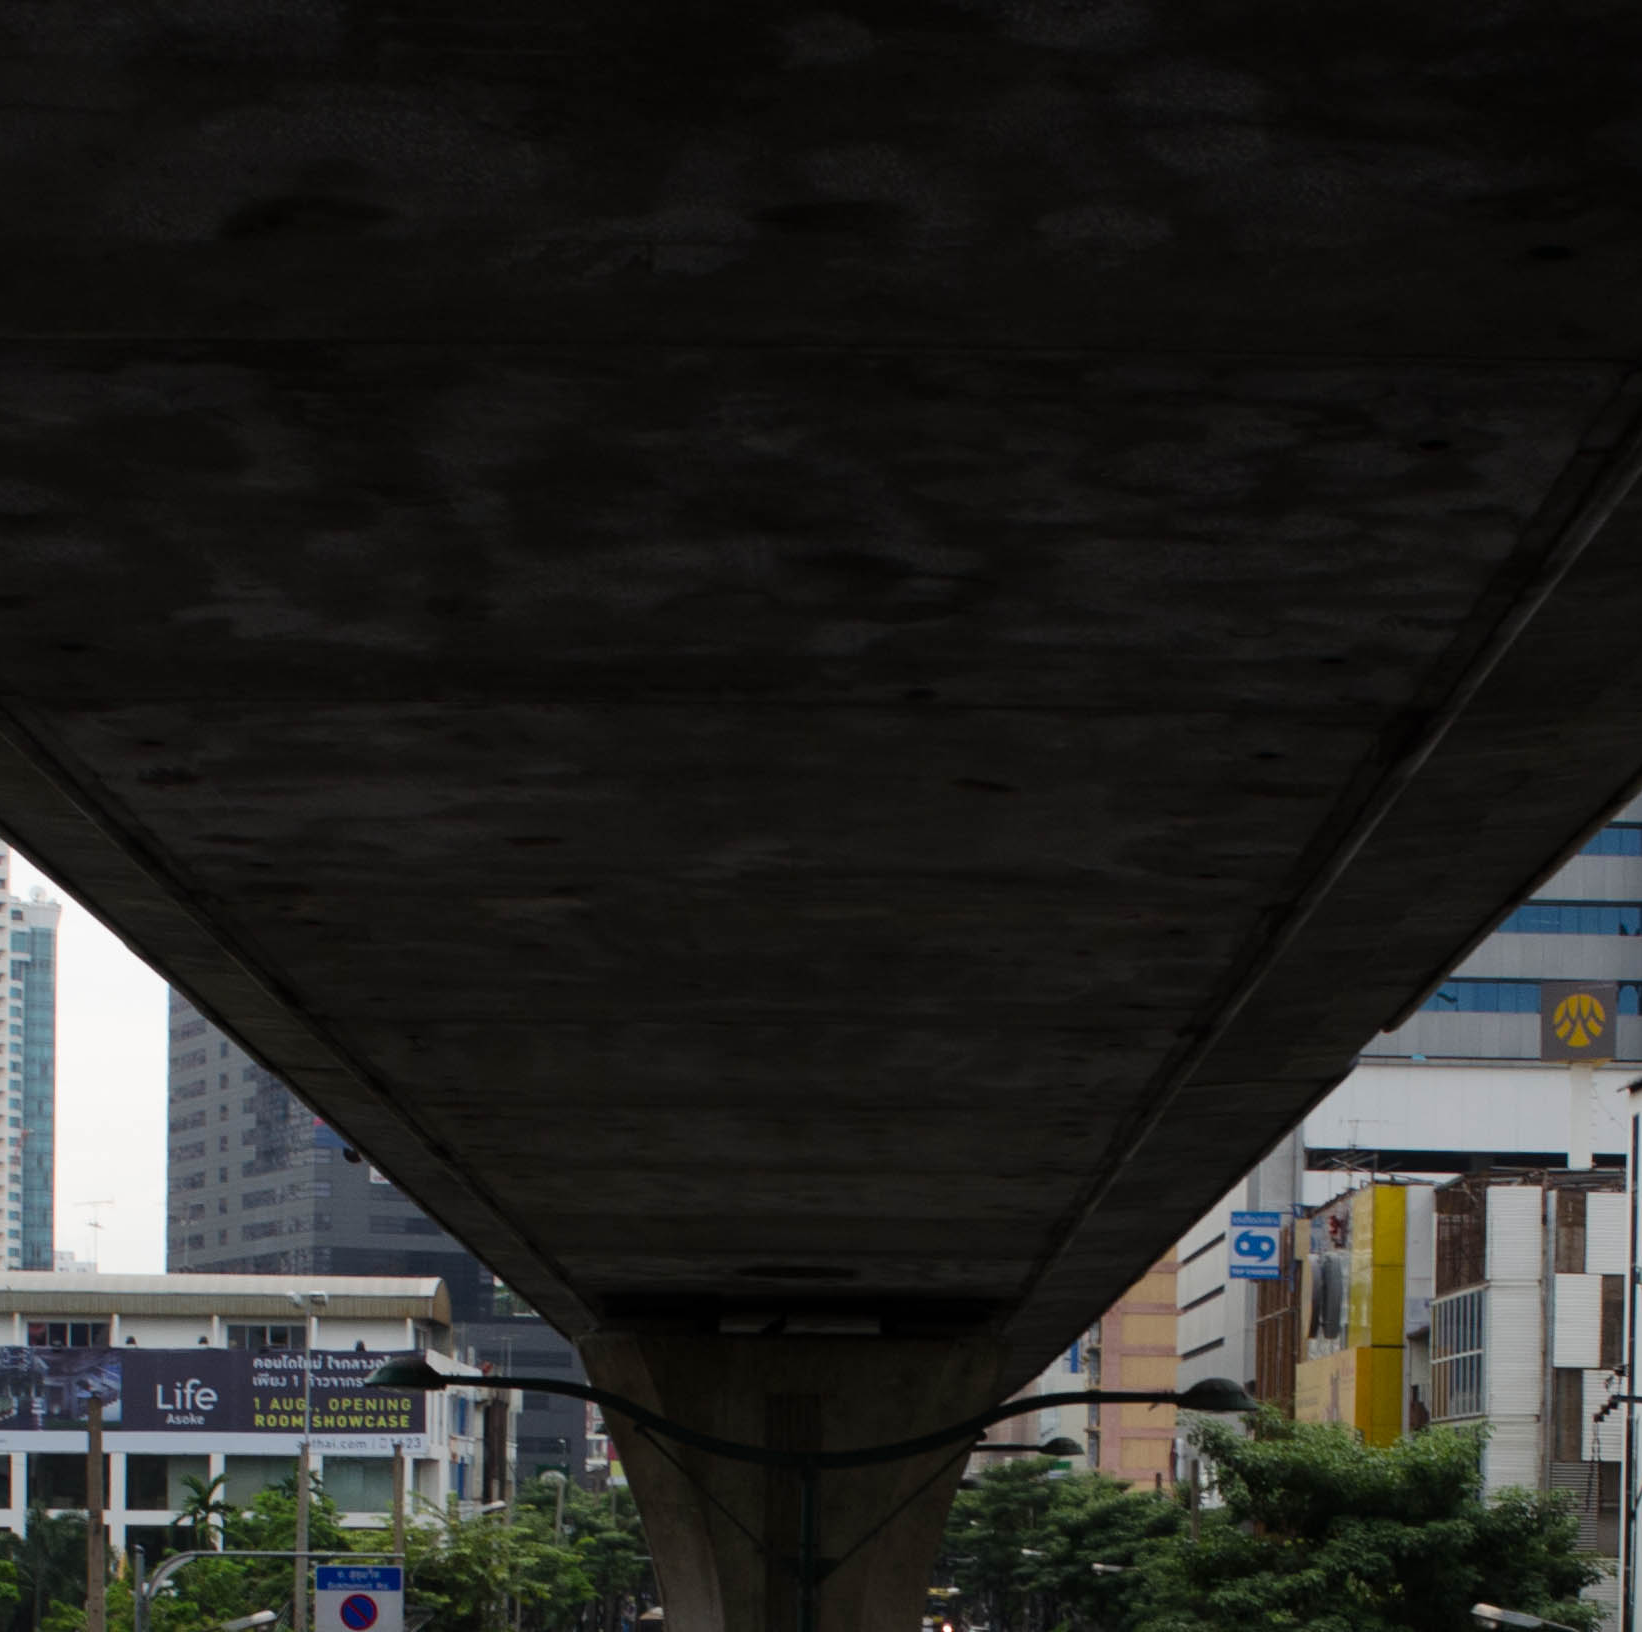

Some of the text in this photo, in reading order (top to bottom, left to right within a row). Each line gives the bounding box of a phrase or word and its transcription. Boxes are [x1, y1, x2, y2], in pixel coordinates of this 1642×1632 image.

[156, 1377, 219, 1411] Life
[254, 1397, 261, 1411] 1
[328, 1397, 413, 1412] OPENING
[165, 1413, 206, 1426] Asoke
[254, 1414, 411, 1428] ROOM SHOWCASE
